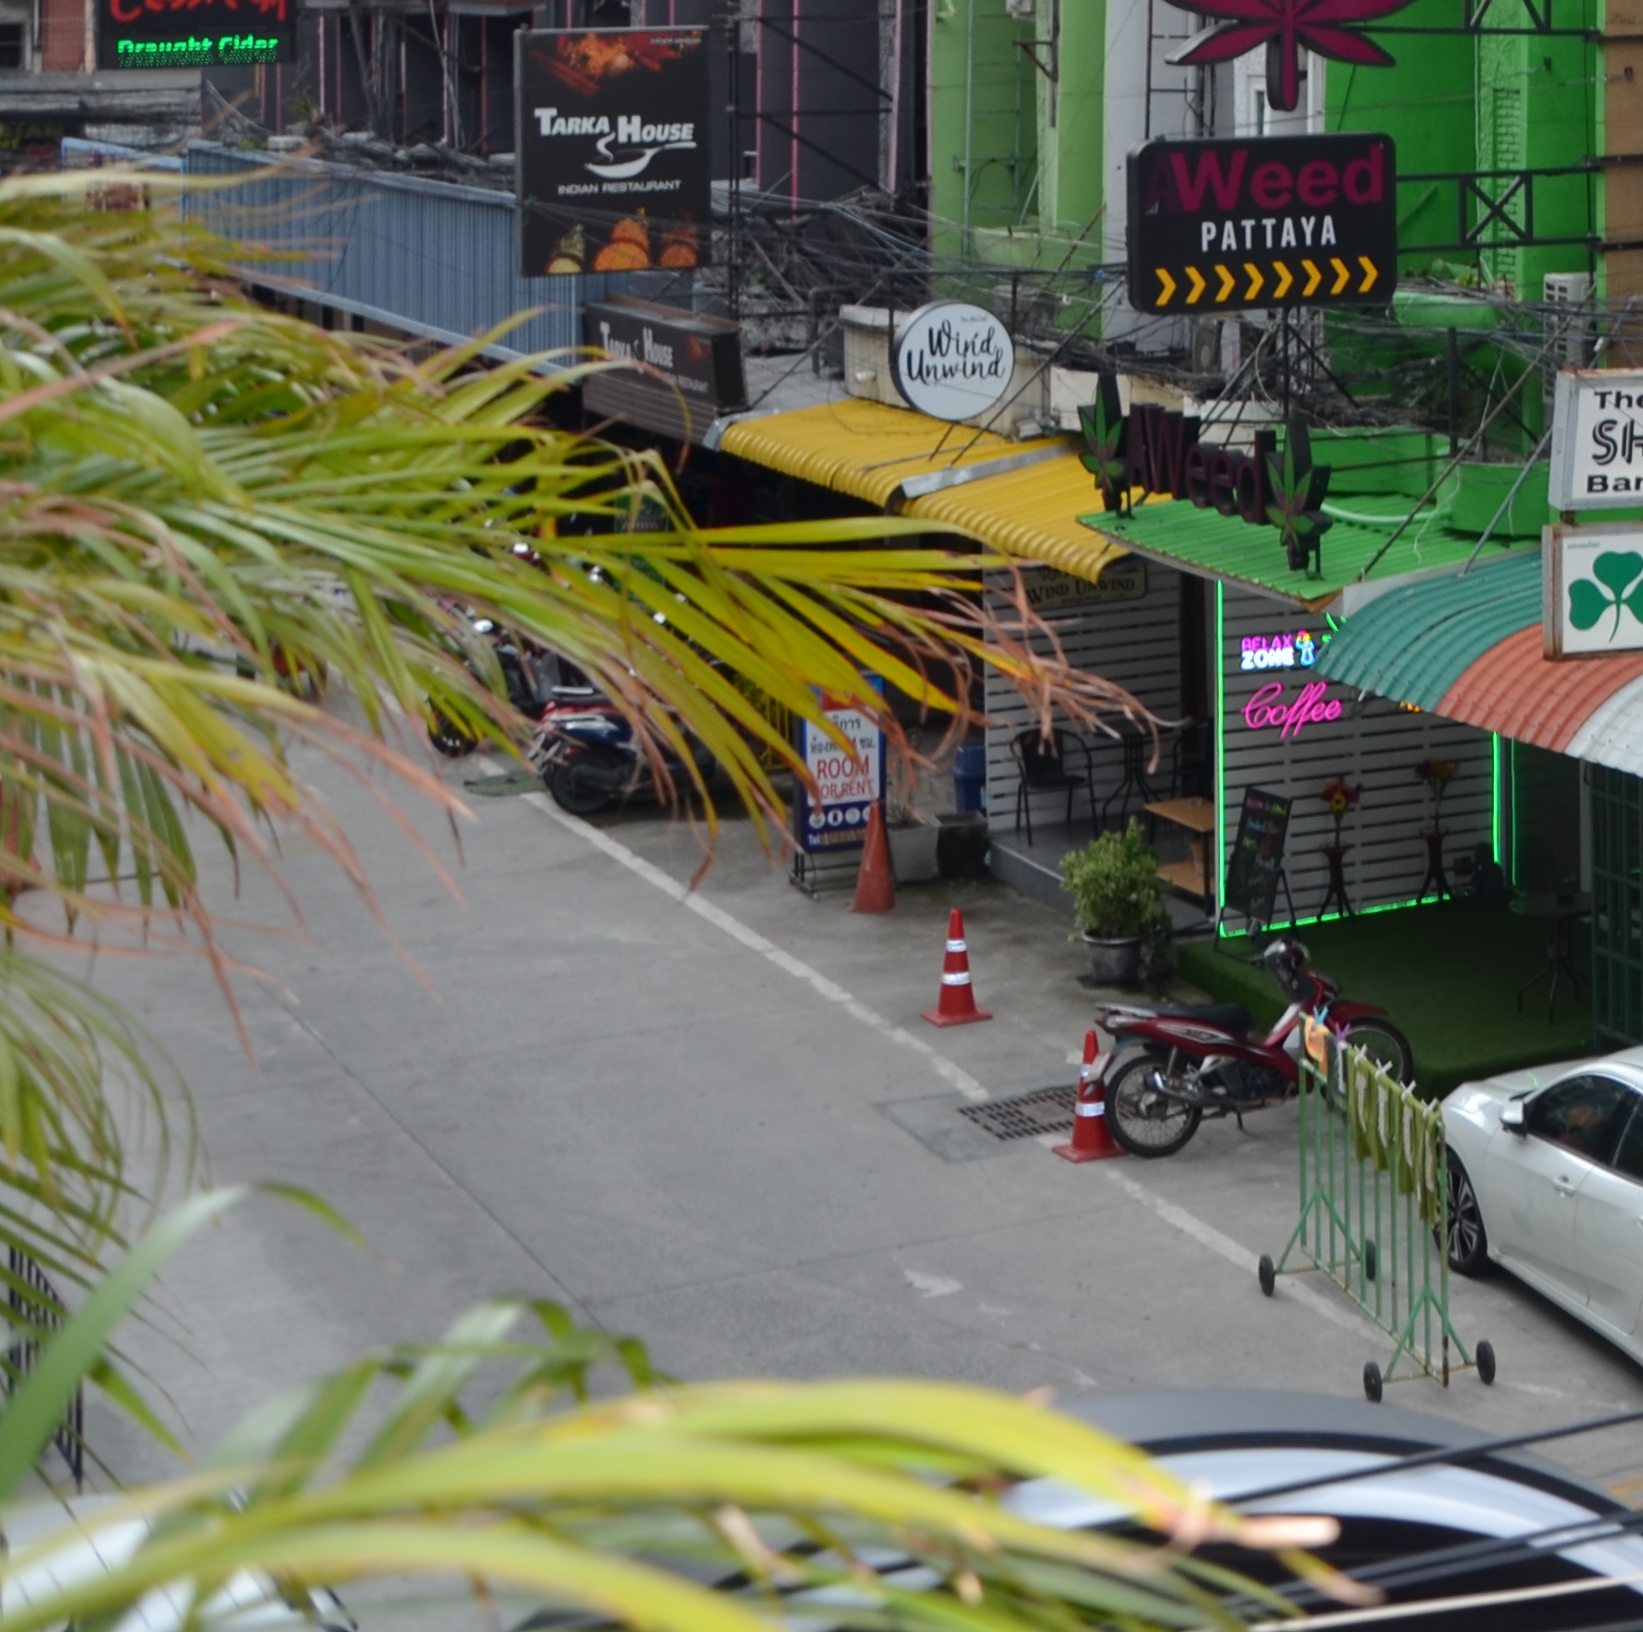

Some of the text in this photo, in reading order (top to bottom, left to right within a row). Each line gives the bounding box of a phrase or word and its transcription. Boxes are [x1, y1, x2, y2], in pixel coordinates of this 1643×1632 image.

[534, 107, 695, 143] TARKA HOUSE
[558, 180, 681, 196] INDIAN RESTAURANT
[1201, 215, 1337, 253] PATTAYA
[928, 319, 998, 357] Wind
[907, 348, 1006, 386] Unwind
[1241, 634, 1293, 652] RELAX
[1241, 648, 1295, 670] ZONE
[1241, 681, 1343, 739] Coffee
